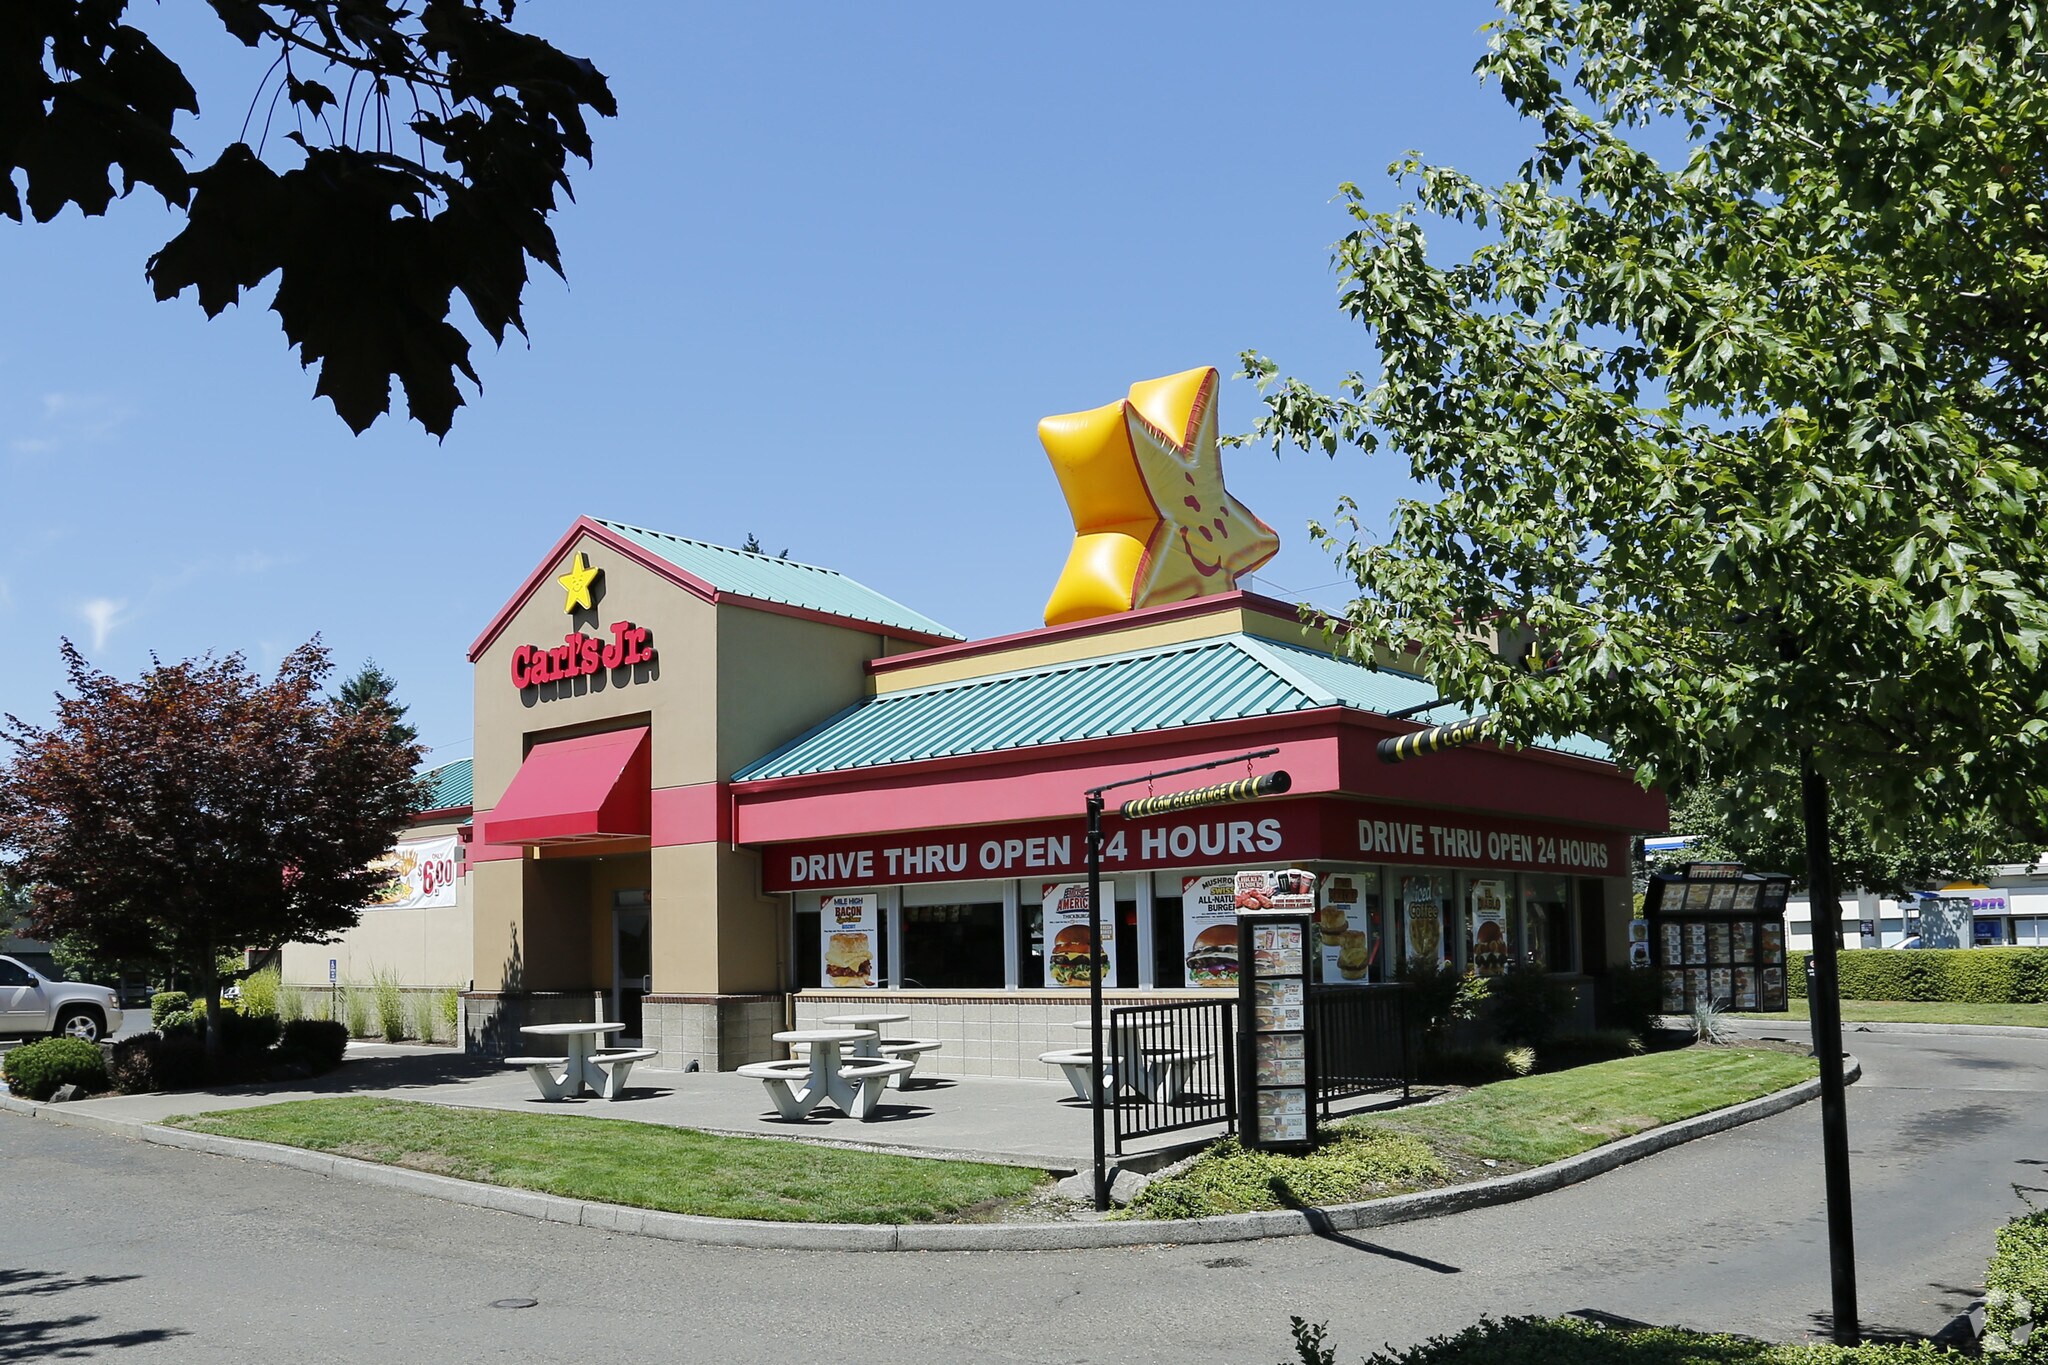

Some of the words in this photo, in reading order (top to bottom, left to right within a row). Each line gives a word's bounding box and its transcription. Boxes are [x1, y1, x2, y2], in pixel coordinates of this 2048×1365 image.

[511, 632, 599, 689] Carl's
[602, 620, 652, 669] Jr.
[1443, 724, 1475, 746] LOW
[1153, 798, 1171, 811] LOW
[1173, 788, 1226, 807] CLEARANCE
[790, 850, 874, 882] DRIVE
[883, 843, 967, 876] THRU
[979, 836, 1070, 870] OPEN
[1141, 818, 1282, 860] HOURS
[1358, 819, 1424, 855] DRIVE
[1429, 826, 1481, 859] THRU
[1488, 831, 1533, 862] OPEN
[1537, 836, 1556, 864] 24
[1560, 838, 1608, 868] HOURS
[1202, 877, 1235, 889] MUSHRO
[848, 897, 864, 905] HIGH
[1057, 896, 1089, 911] AMERIC
[1198, 895, 1236, 904] ALL-NATU
[835, 906, 862, 917] BACON
[1409, 901, 1439, 919] Coffee
